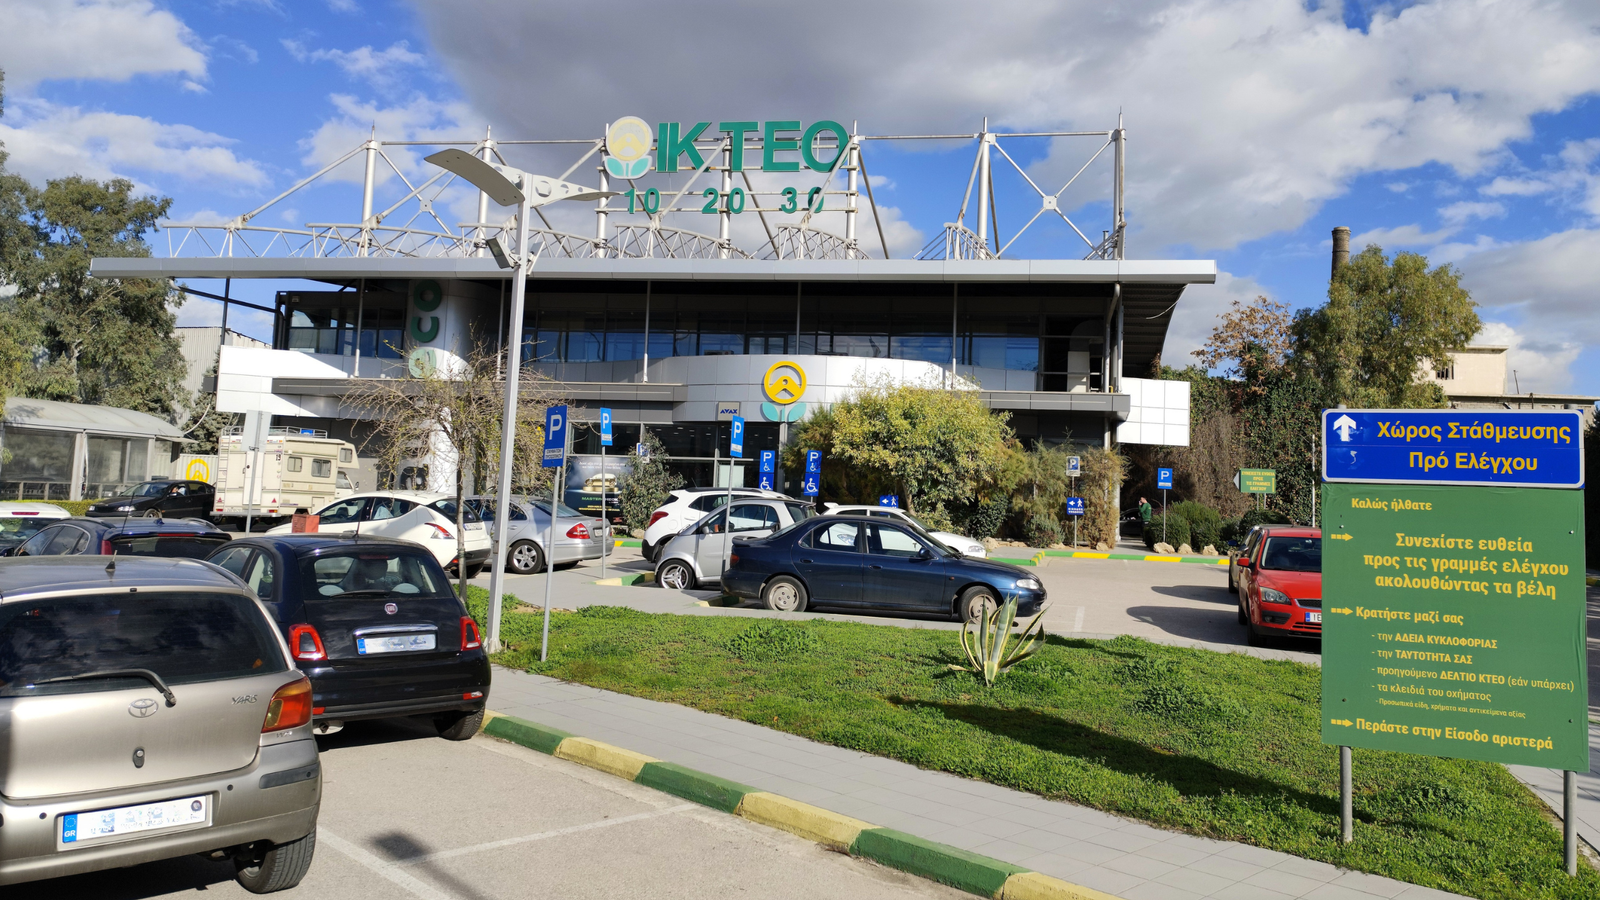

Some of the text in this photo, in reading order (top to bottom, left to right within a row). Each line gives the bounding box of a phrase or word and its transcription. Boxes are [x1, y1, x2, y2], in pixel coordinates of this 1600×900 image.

[624, 186, 825, 215] 10 20 30
[548, 414, 562, 440] P
[602, 413, 610, 429] P
[734, 421, 742, 439] P
[1377, 420, 1571, 444] Χώρος Στάθμευσης
[763, 452, 772, 462] P
[809, 452, 819, 462] P
[1069, 458, 1077, 468] P
[1409, 451, 1538, 474] Πρό Ελέγχου
[1160, 471, 1170, 480] P
[1351, 498, 1432, 512] Καλώς ήλθατε
[1395, 532, 1533, 553] Συνεχίστε ευθεία
[1363, 555, 1569, 579] προς τις γραμμές ελέγχου
[1375, 574, 1557, 600] ακολουθώντας τα βέλη
[1355, 606, 1464, 626] Κρατήστε μαζί σας
[1377, 633, 1498, 649] την ΑΔΕΙΑ ΚΥΚΛΟΦΟΡΙΑΣ
[1377, 649, 1473, 665] την ΤΑΥΤΟΤΗΤΑ ΣΑΣ
[1376, 666, 1575, 692] προηγούμενο ΔΕΛΤΙΟ ΚΤΕΟ (εάν υπάρχει)
[231, 694, 258, 705] YARIS
[1377, 683, 1492, 702] τα κλειδιά του οχήματος
[1355, 718, 1554, 751] Περάστε στην Είσοδο αριστερά
[64, 830, 76, 838] GR
